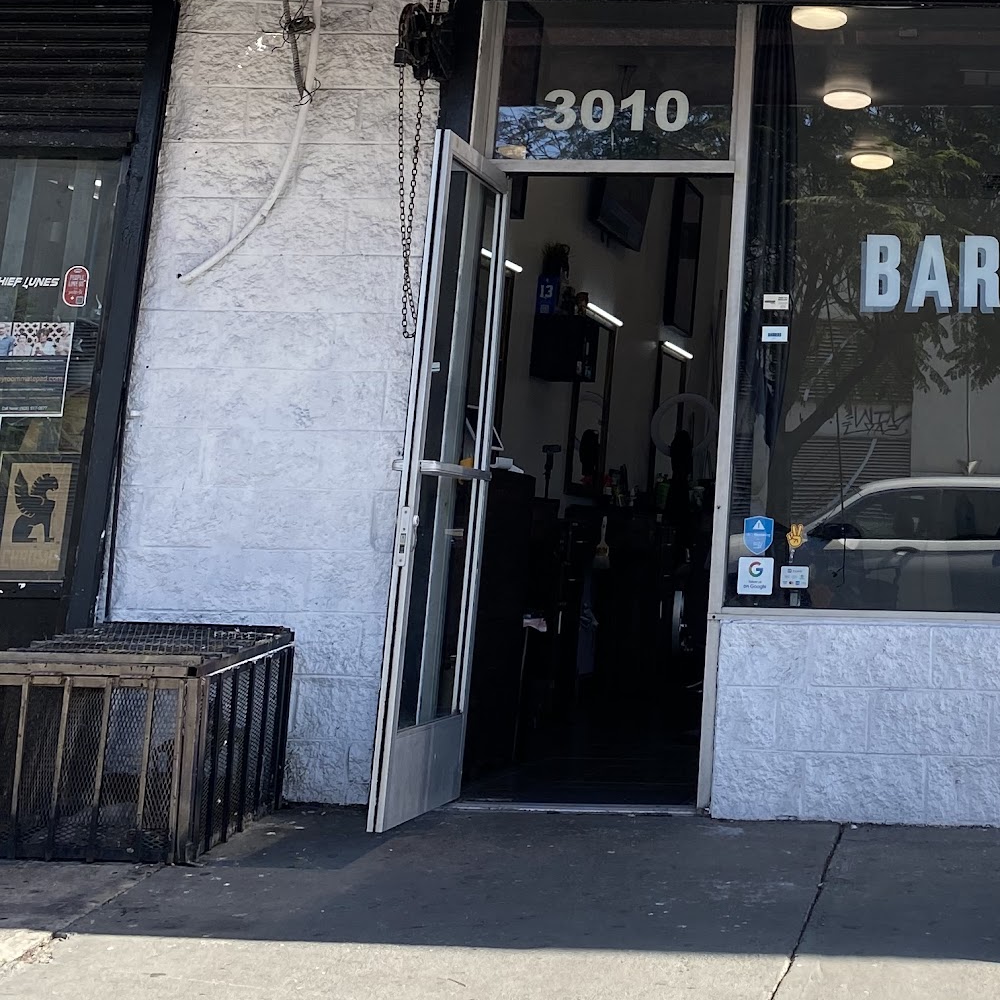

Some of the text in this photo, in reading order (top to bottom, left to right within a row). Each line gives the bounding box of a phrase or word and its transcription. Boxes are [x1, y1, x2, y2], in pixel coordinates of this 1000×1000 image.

[542, 88, 690, 132] 3010
[539, 284, 554, 298] 13
[748, 561, 764, 578] G
